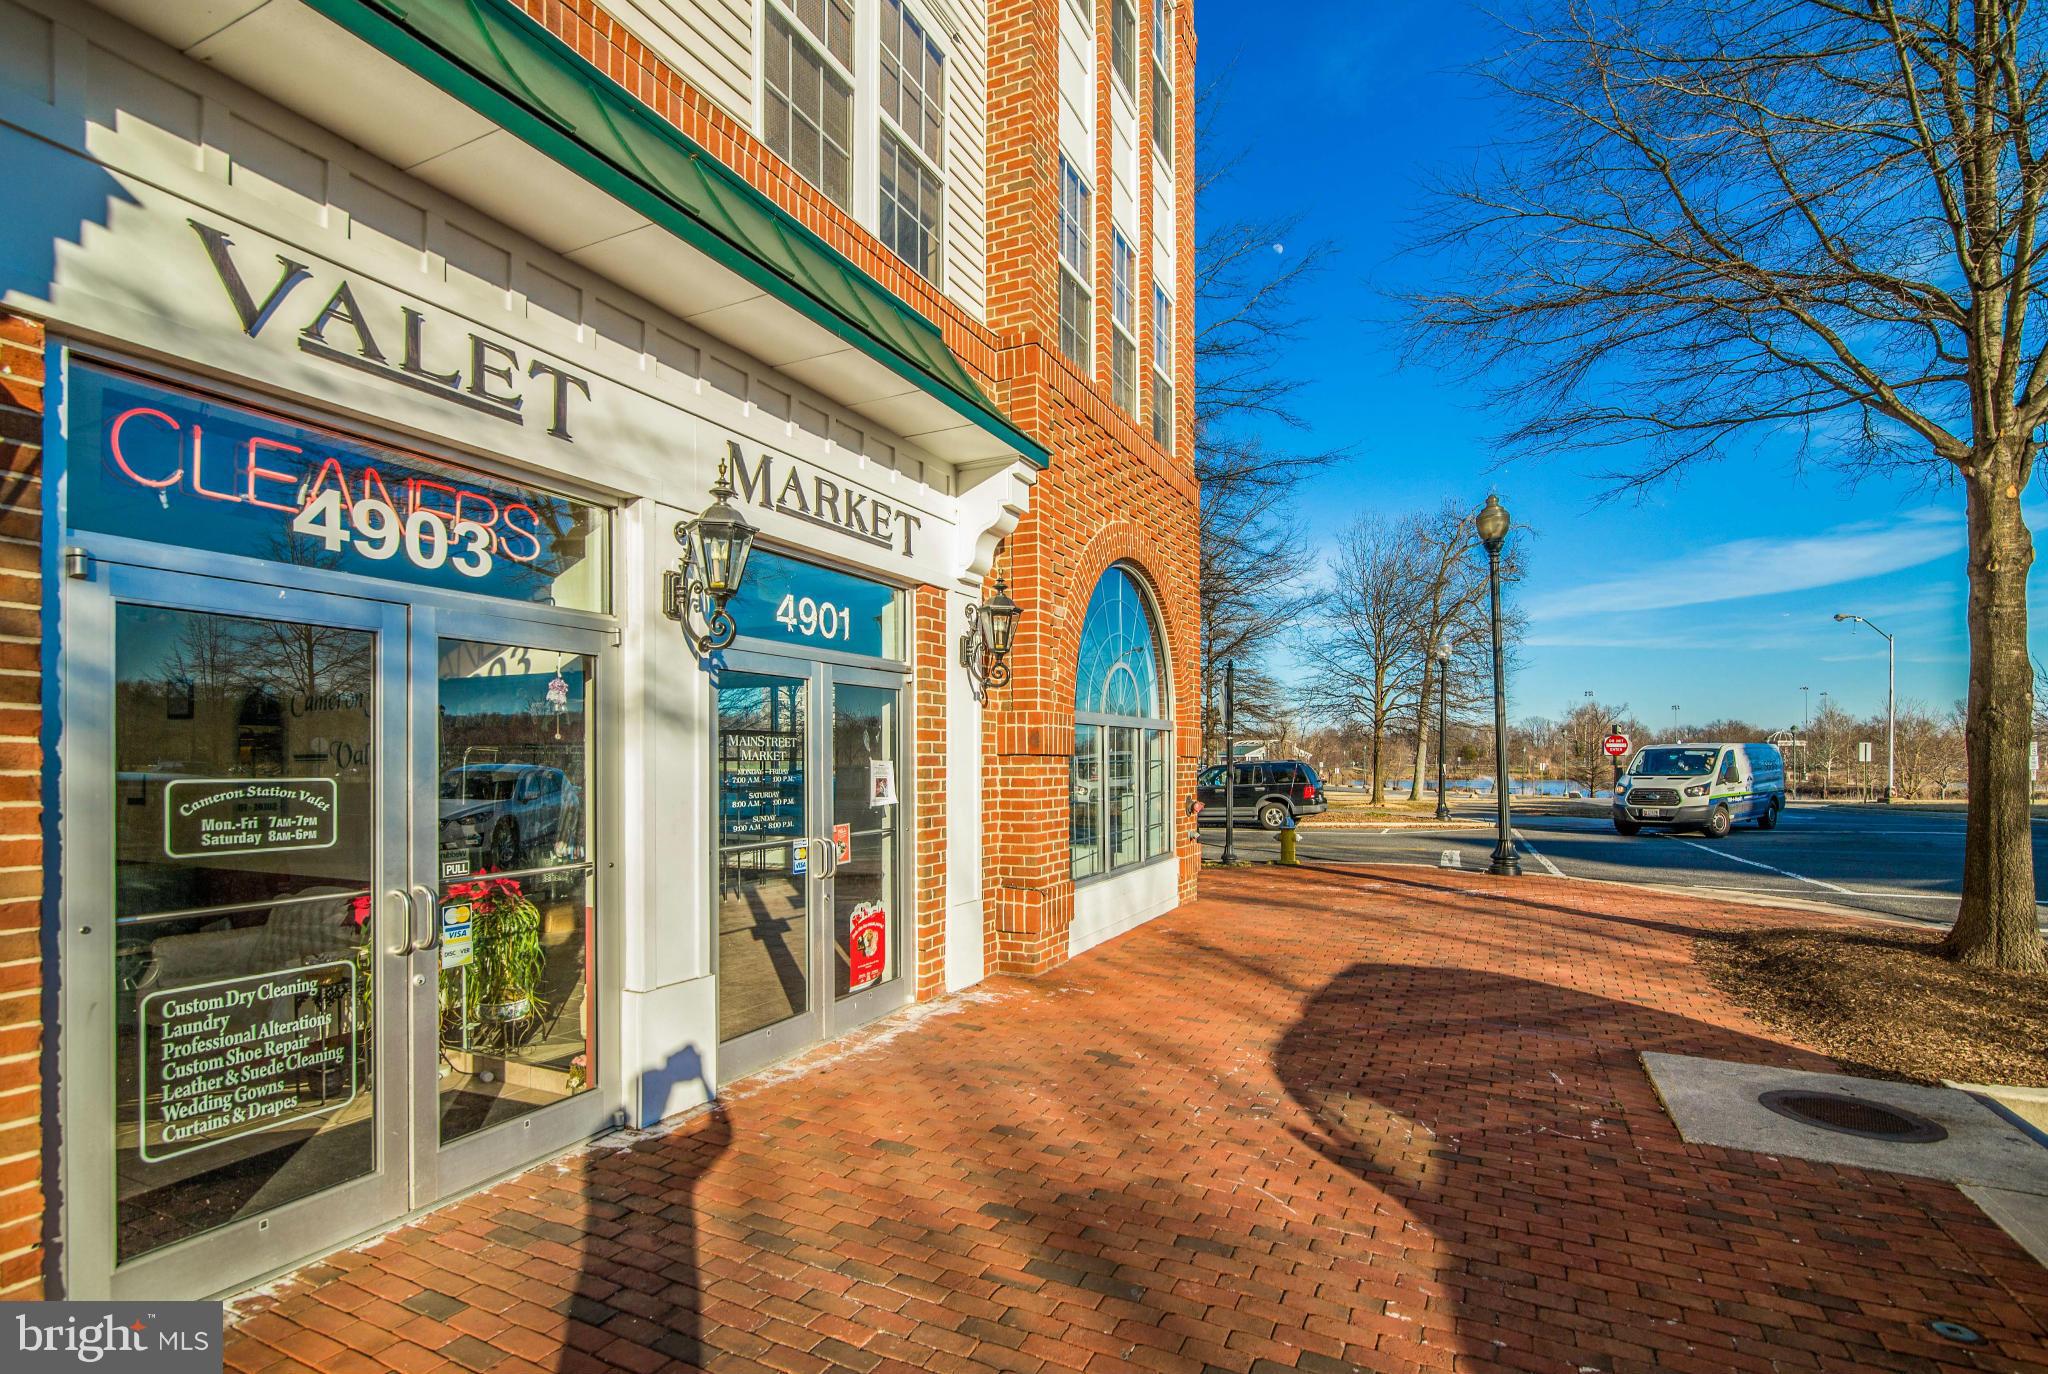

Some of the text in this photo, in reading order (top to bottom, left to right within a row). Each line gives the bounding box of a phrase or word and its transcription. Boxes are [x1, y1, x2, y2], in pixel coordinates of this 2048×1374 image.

[187, 218, 591, 443] VALET
[110, 408, 541, 562] CLEANERS
[726, 439, 921, 558] MARKET
[293, 488, 493, 578] 4903
[776, 594, 850, 641] 4901
[741, 749, 787, 761] MARKET
[179, 789, 245, 817] Cameron
[246, 785, 297, 799] Station
[299, 790, 331, 812] Valet
[749, 791, 780, 800] SATURDAY
[201, 831, 262, 847] Saturday
[752, 815, 776, 823] SUNDAY
[446, 863, 468, 875] PULL
[449, 930, 467, 939] VISA
[162, 979, 319, 1018] Custom Dry Cleaning
[161, 1013, 231, 1040] Laundry
[161, 1012, 332, 1060] Professional Alterations
[161, 1046, 345, 1103] Leather & Suede Cleaning
[162, 1034, 311, 1081] Custom Shoe Repair
[162, 1079, 285, 1123] Wedding Gowns
[162, 1095, 298, 1143] Curtains & Drapes
